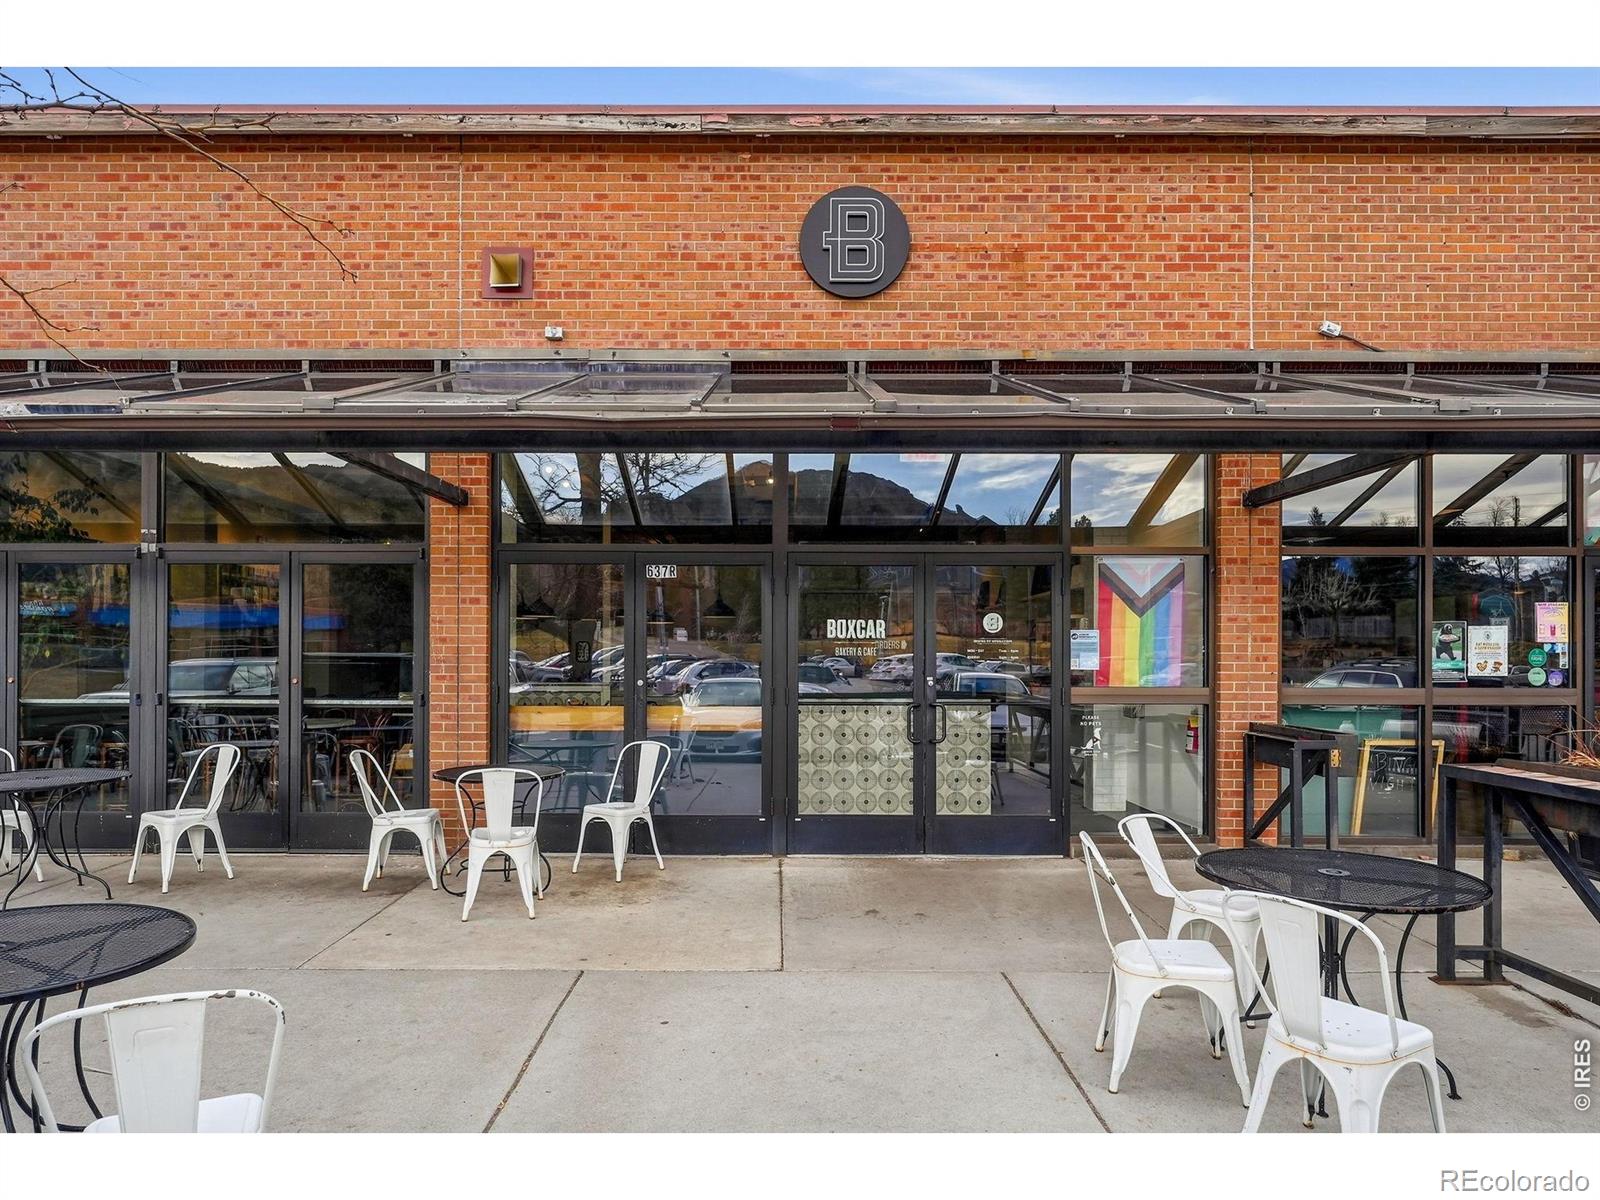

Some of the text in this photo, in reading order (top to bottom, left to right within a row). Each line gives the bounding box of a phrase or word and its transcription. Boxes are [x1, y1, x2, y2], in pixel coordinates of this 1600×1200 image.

[822, 197, 885, 283] B
[647, 565, 676, 578] 637R
[826, 619, 886, 639] BOXCAR
[834, 646, 856, 657] BAKERY
[857, 646, 863, 656] &
